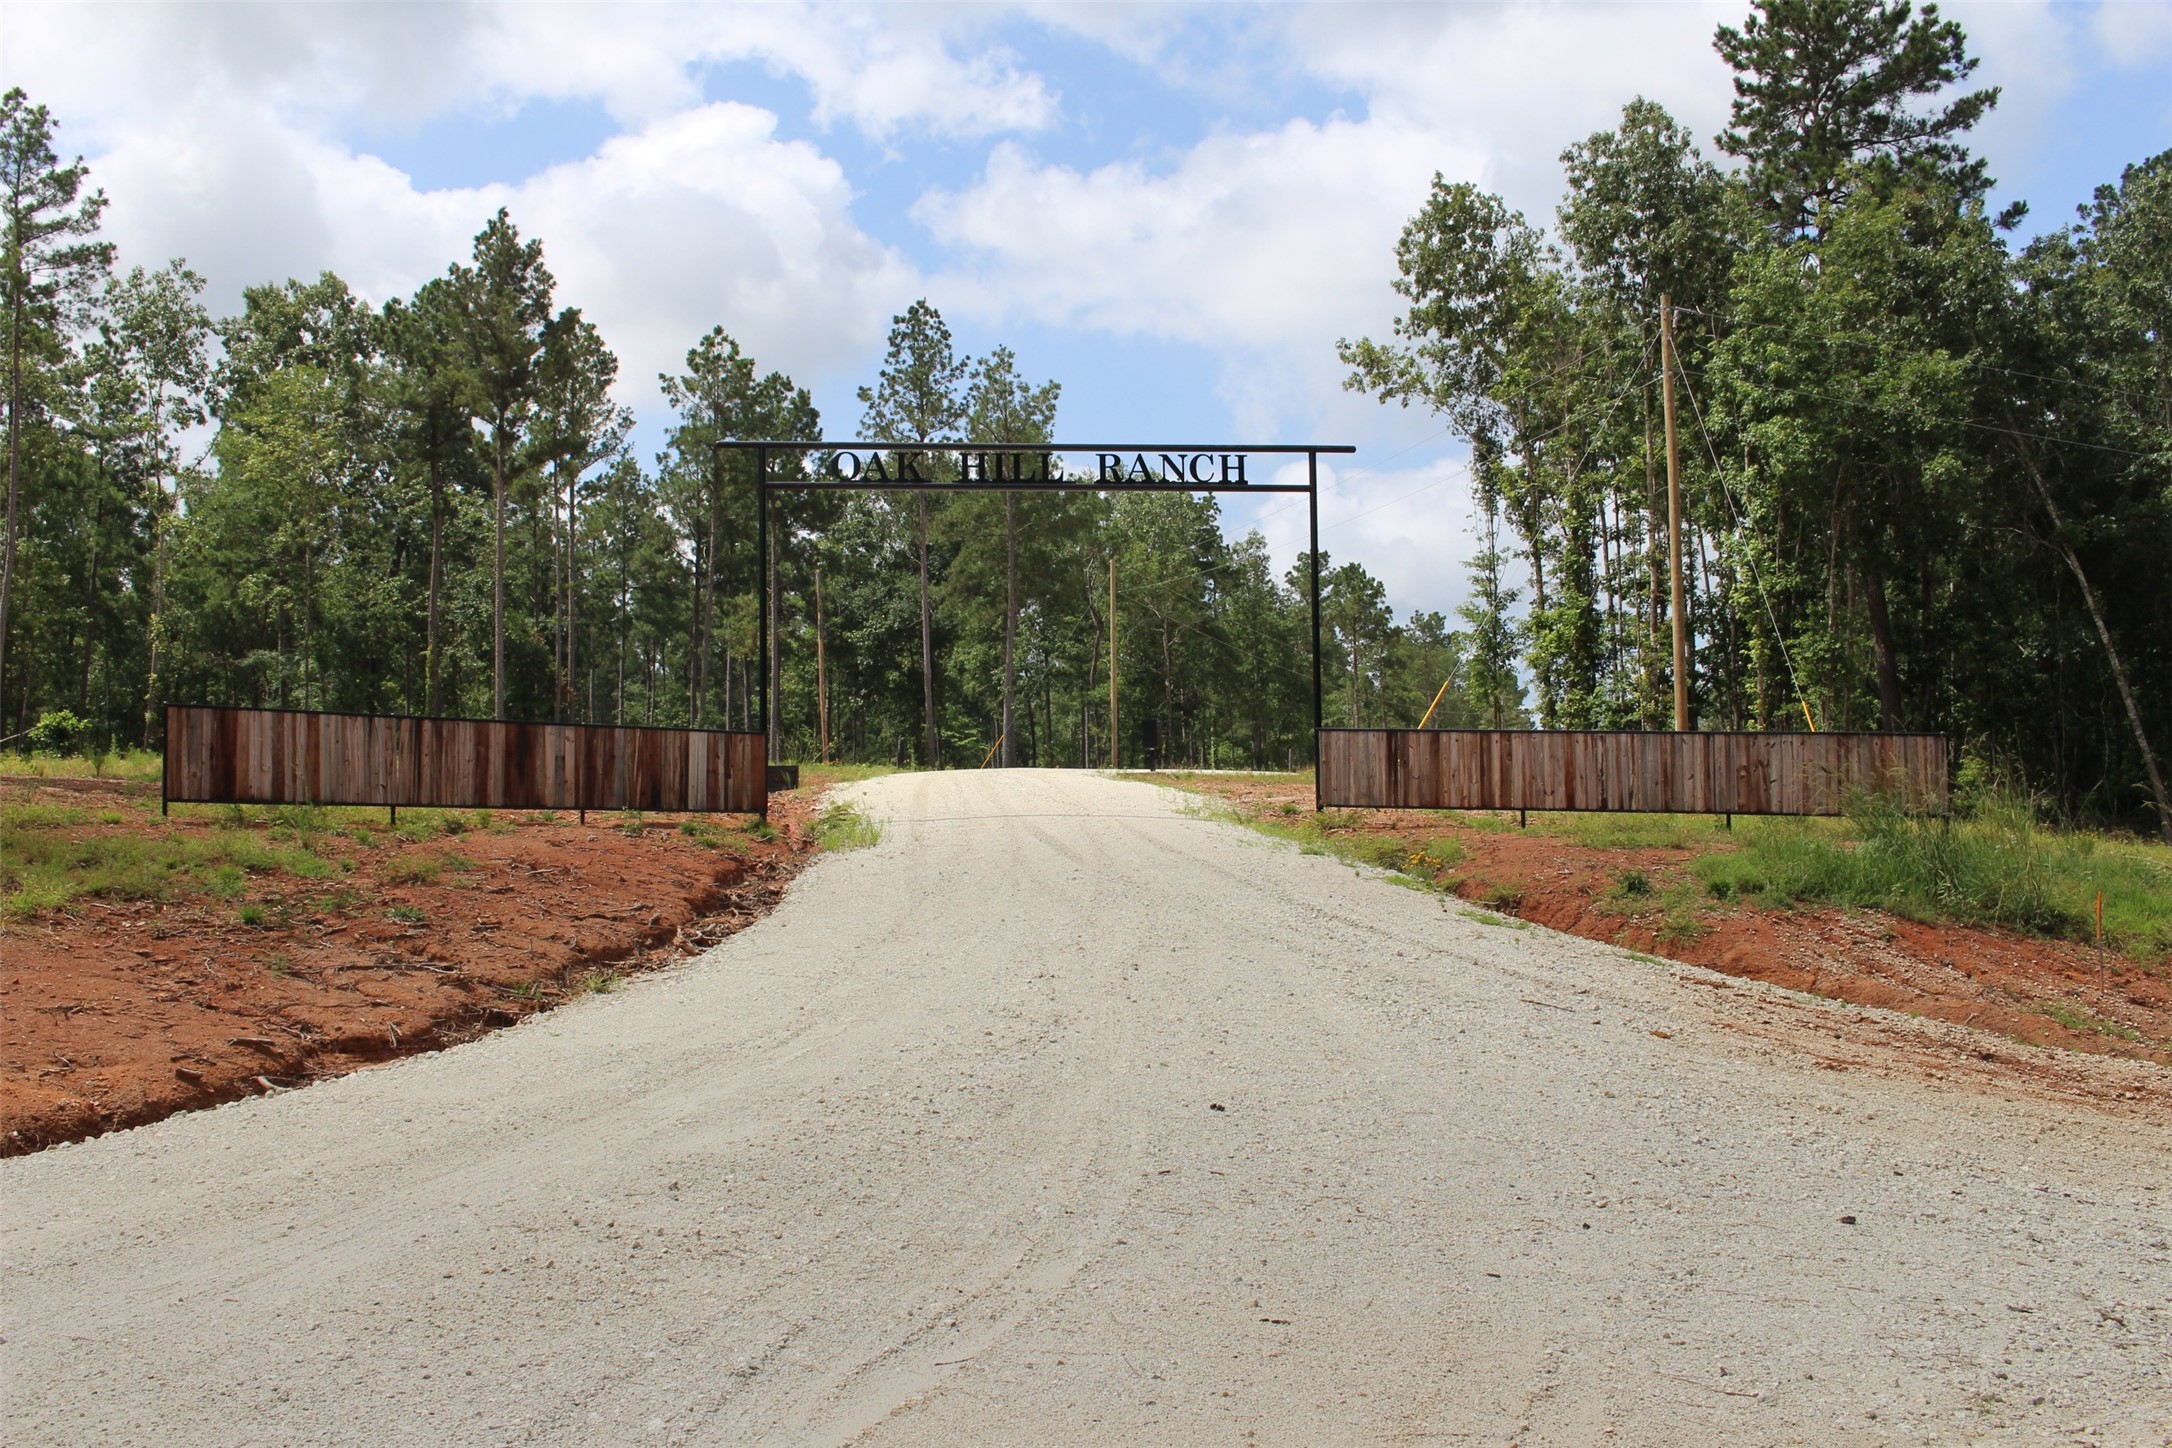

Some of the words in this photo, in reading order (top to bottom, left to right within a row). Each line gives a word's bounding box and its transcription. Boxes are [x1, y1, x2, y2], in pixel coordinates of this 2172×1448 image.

[831, 451, 929, 482] OAK
[957, 452, 1065, 482] HILL
[1094, 453, 1248, 484] RANCH
